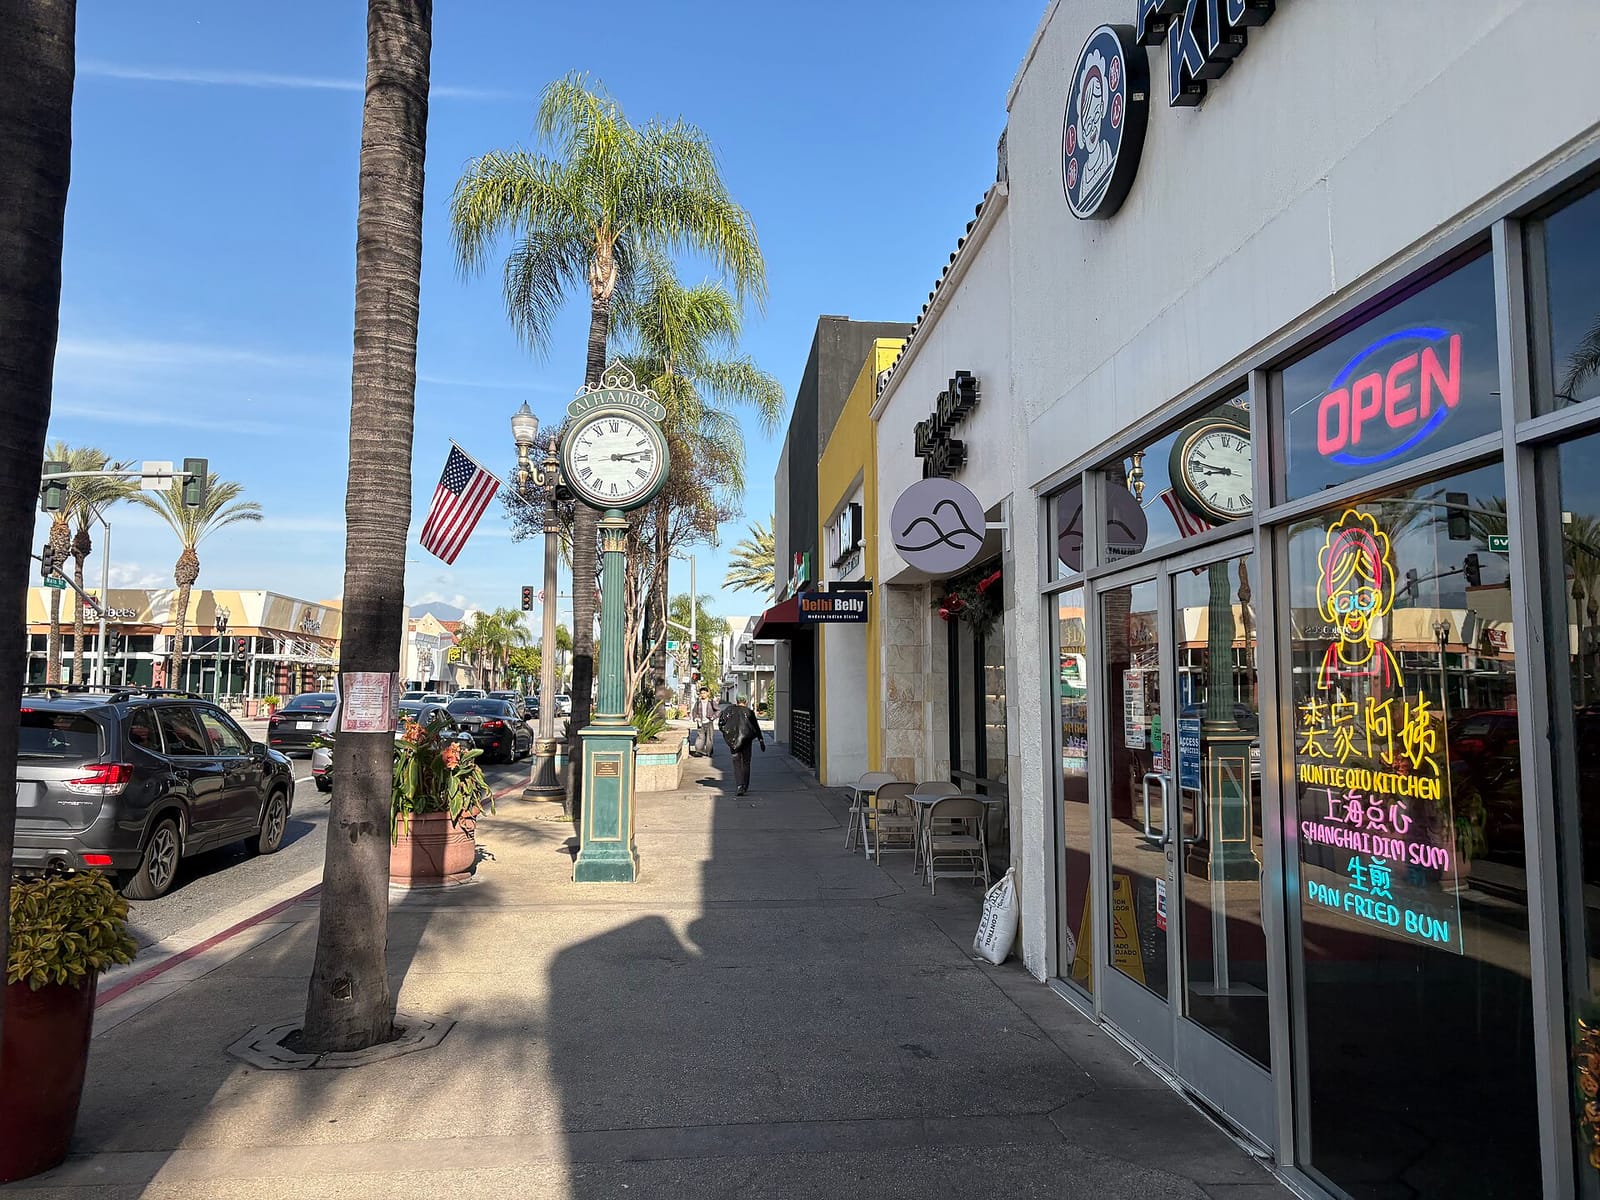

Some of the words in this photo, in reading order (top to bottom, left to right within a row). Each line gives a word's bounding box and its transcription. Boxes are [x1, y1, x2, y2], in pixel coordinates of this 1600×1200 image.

[575, 391, 661, 418] ALHAMBRA
[1317, 334, 1463, 457] OPEN
[802, 598, 833, 611] Delhi
[834, 598, 864, 612] Belly
[1180, 736, 1199, 747] ACCESS
[1298, 690, 1440, 777] 裘家阿姨
[1300, 763, 1345, 787] AUNTIE
[1346, 769, 1371, 791] QIU
[1373, 771, 1441, 800] KITCHEN
[1323, 788, 1413, 834] 上海点心
[1301, 821, 1371, 855] SHANGHAI
[1373, 835, 1406, 862] DIM
[1410, 843, 1449, 872] SUM
[1347, 855, 1393, 900] 生煎
[984, 913, 998, 947] CONTROL
[1308, 880, 1341, 908] PAN
[1344, 892, 1400, 927] FRIED
[1405, 909, 1449, 943] BUN
